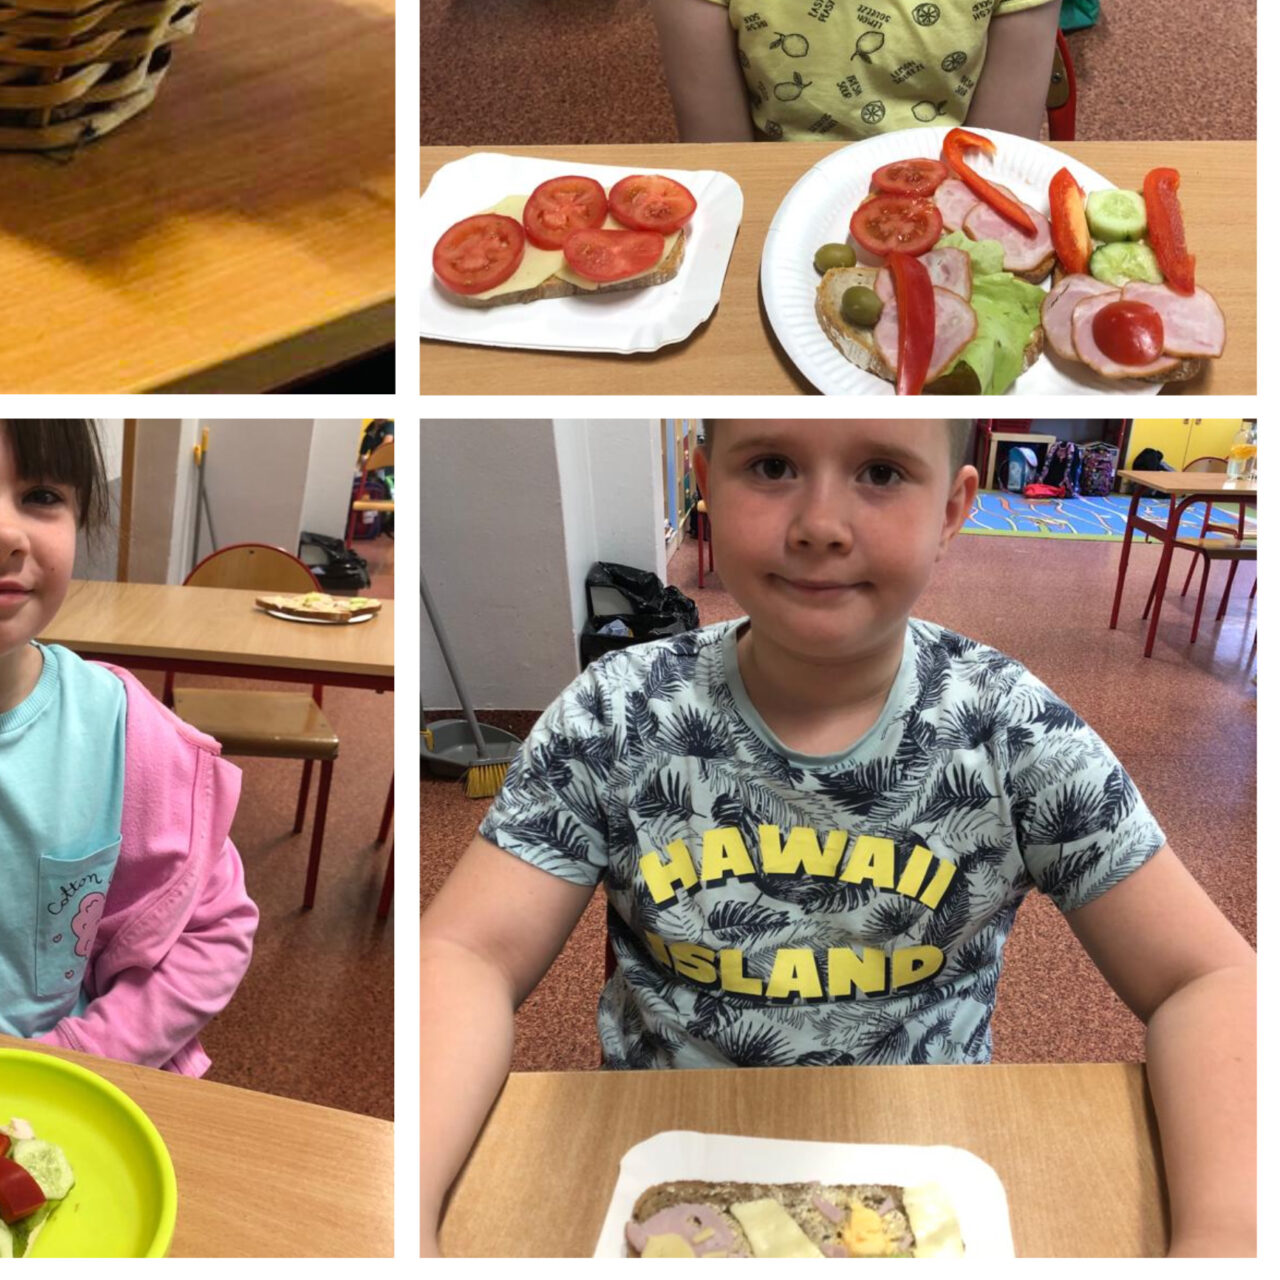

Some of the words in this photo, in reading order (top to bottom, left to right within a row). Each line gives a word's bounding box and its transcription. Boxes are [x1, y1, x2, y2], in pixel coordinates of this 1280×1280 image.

[47, 873, 103, 916] Cotton
[638, 823, 958, 911] HAWAII
[644, 929, 948, 1000] ISLAND
